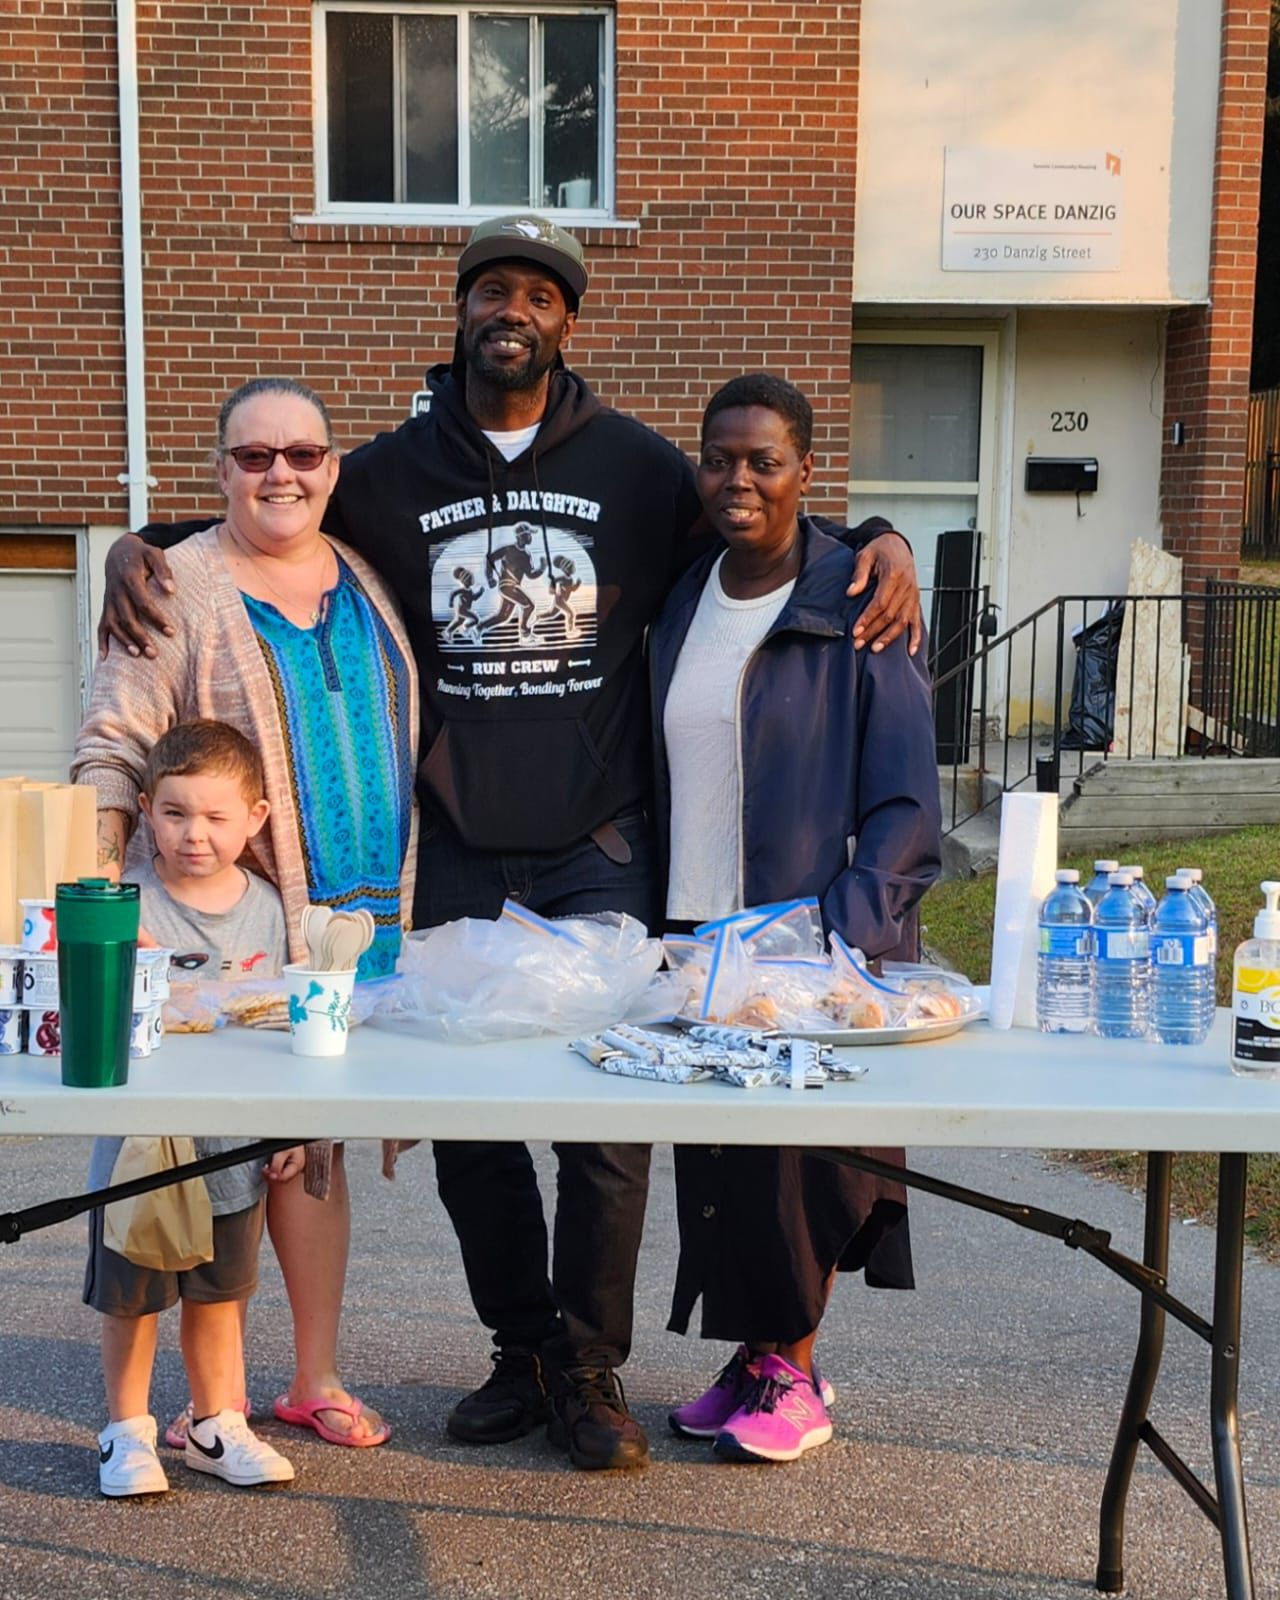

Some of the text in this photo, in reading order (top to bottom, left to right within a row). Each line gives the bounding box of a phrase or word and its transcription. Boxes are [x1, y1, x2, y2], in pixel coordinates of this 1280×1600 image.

[951, 203, 1116, 221] OUR SPACE DANZIG
[974, 245, 1091, 262] 230 Danzig Street
[1051, 411, 1088, 432] 230
[418, 490, 601, 534] FATHER & DAUGHTER
[472, 659, 559, 675] RUN CREW
[520, 680, 565, 697] Bonding
[567, 676, 603, 692] Forever
